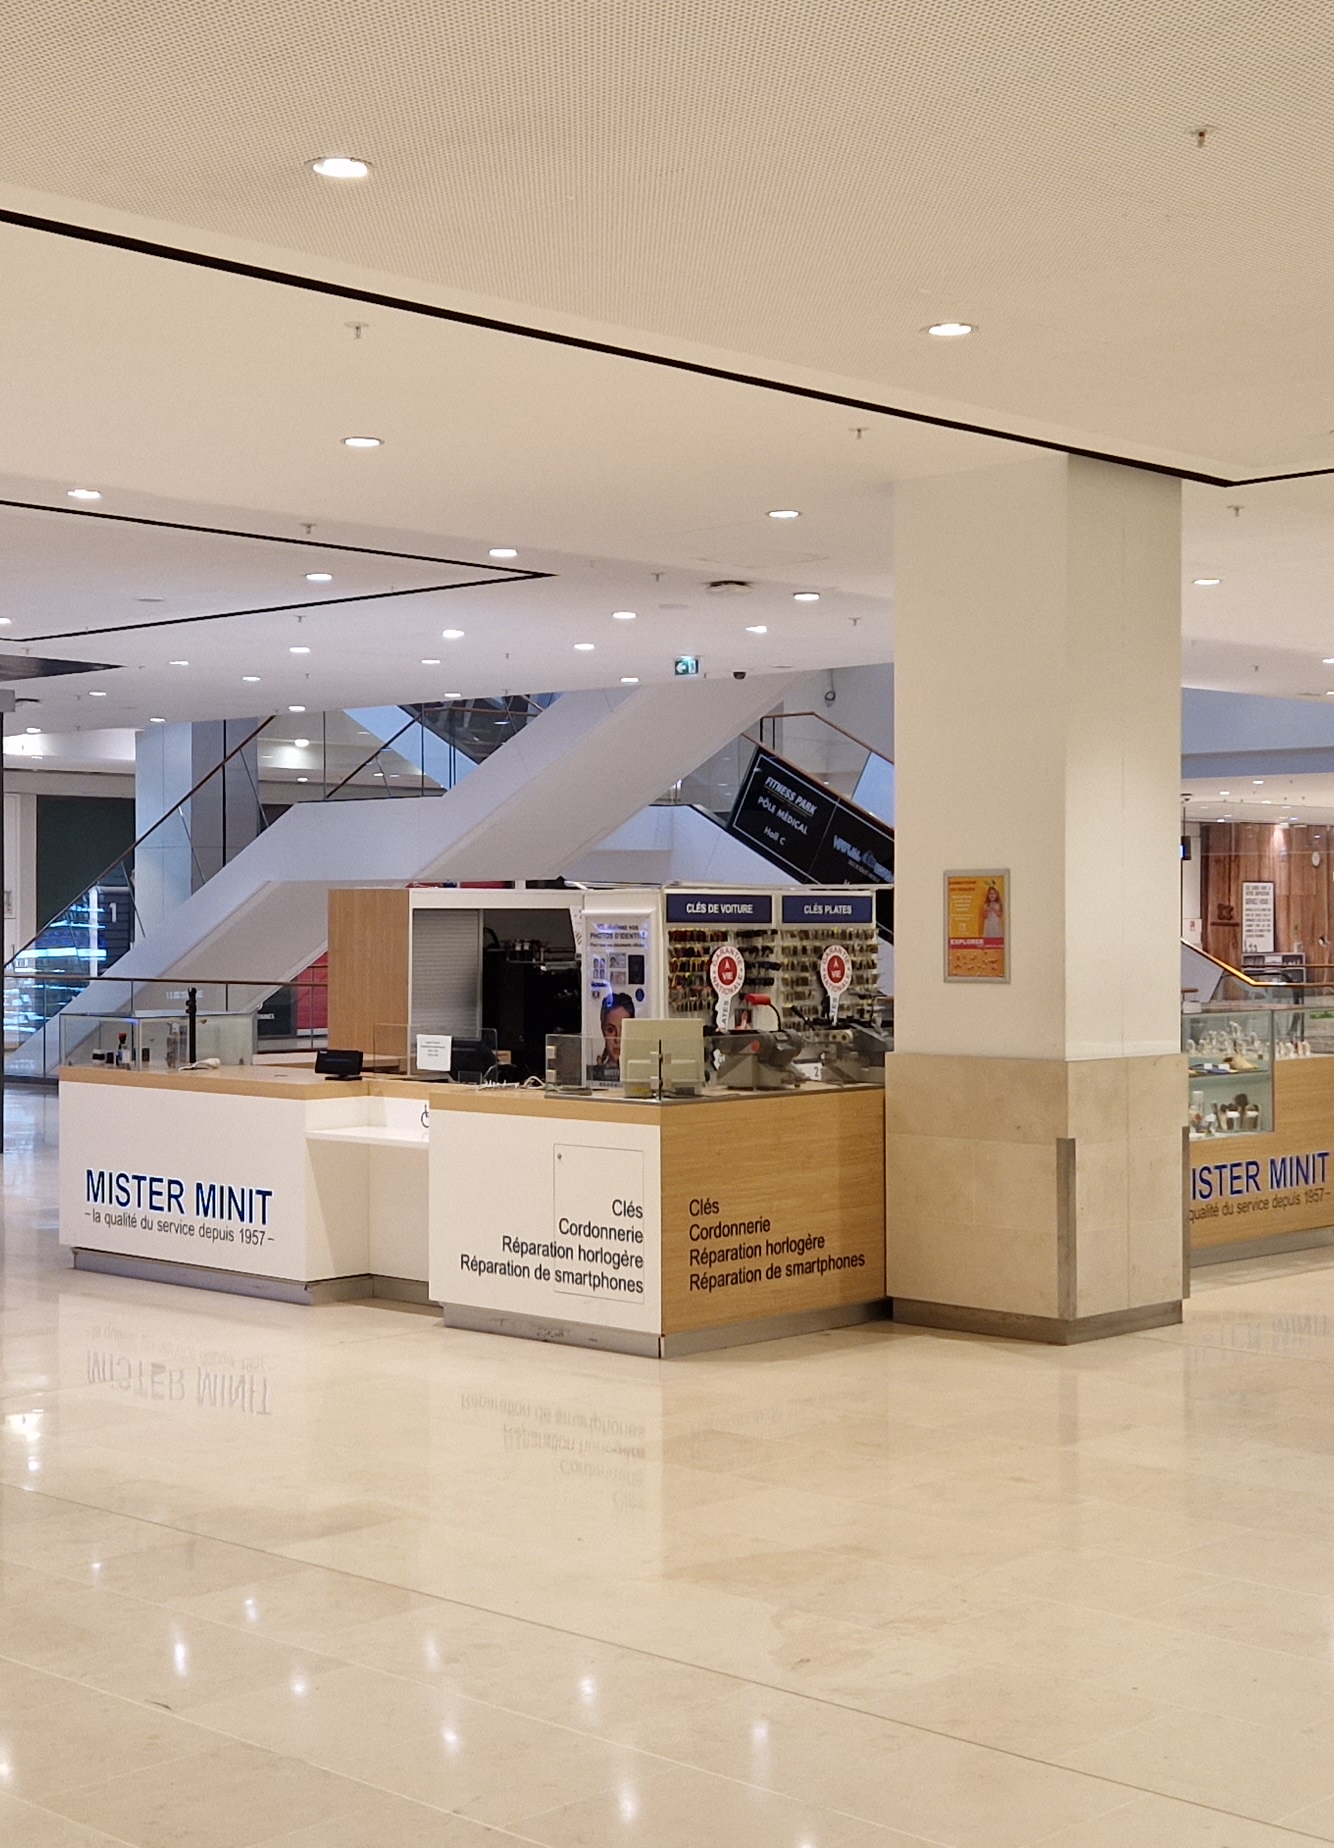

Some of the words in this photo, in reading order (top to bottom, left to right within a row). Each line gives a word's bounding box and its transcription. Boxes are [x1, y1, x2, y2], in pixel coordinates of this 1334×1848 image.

[765, 776, 796, 802] FITNESS
[795, 795, 817, 816] PARK
[764, 826, 779, 842] Hall
[779, 837, 786, 846] C
[108, 902, 117, 923] 1
[686, 903, 707, 914] CLÉS
[708, 903, 719, 914] DE
[720, 904, 754, 915] VOITURE
[804, 903, 823, 915] CLÉS
[825, 904, 852, 915] PLATES
[1191, 1160, 1262, 1201] ISTER
[1269, 1151, 1330, 1191] MINIT
[86, 1169, 185, 1214] MISTER
[195, 1182, 273, 1225] MINIT
[612, 1199, 643, 1219] Clés
[689, 1197, 719, 1217] Clés
[1188, 1199, 1218, 1224] qualité
[1222, 1202, 1234, 1216] du
[1236, 1197, 1269, 1215] service
[1273, 1191, 1301, 1212] depuis
[1304, 1187, 1324, 1204] 1957
[104, 1211, 137, 1229] qualité
[140, 1215, 153, 1231] du
[157, 1219, 195, 1237] service
[199, 1222, 234, 1243] depuis
[239, 1228, 265, 1246] 1957
[559, 1217, 643, 1243] Cordonnerie
[689, 1216, 770, 1242] Cordonnerie
[502, 1235, 574, 1261] Réparation
[578, 1244, 643, 1270] horlogère
[690, 1243, 762, 1268] Réparation
[766, 1233, 825, 1256] horlogère
[460, 1254, 530, 1279] Réparation
[534, 1264, 551, 1281] de
[554, 1268, 644, 1294] smartphones
[690, 1267, 762, 1293] Réparation
[766, 1262, 782, 1280] de
[785, 1253, 865, 1277] smartphones
